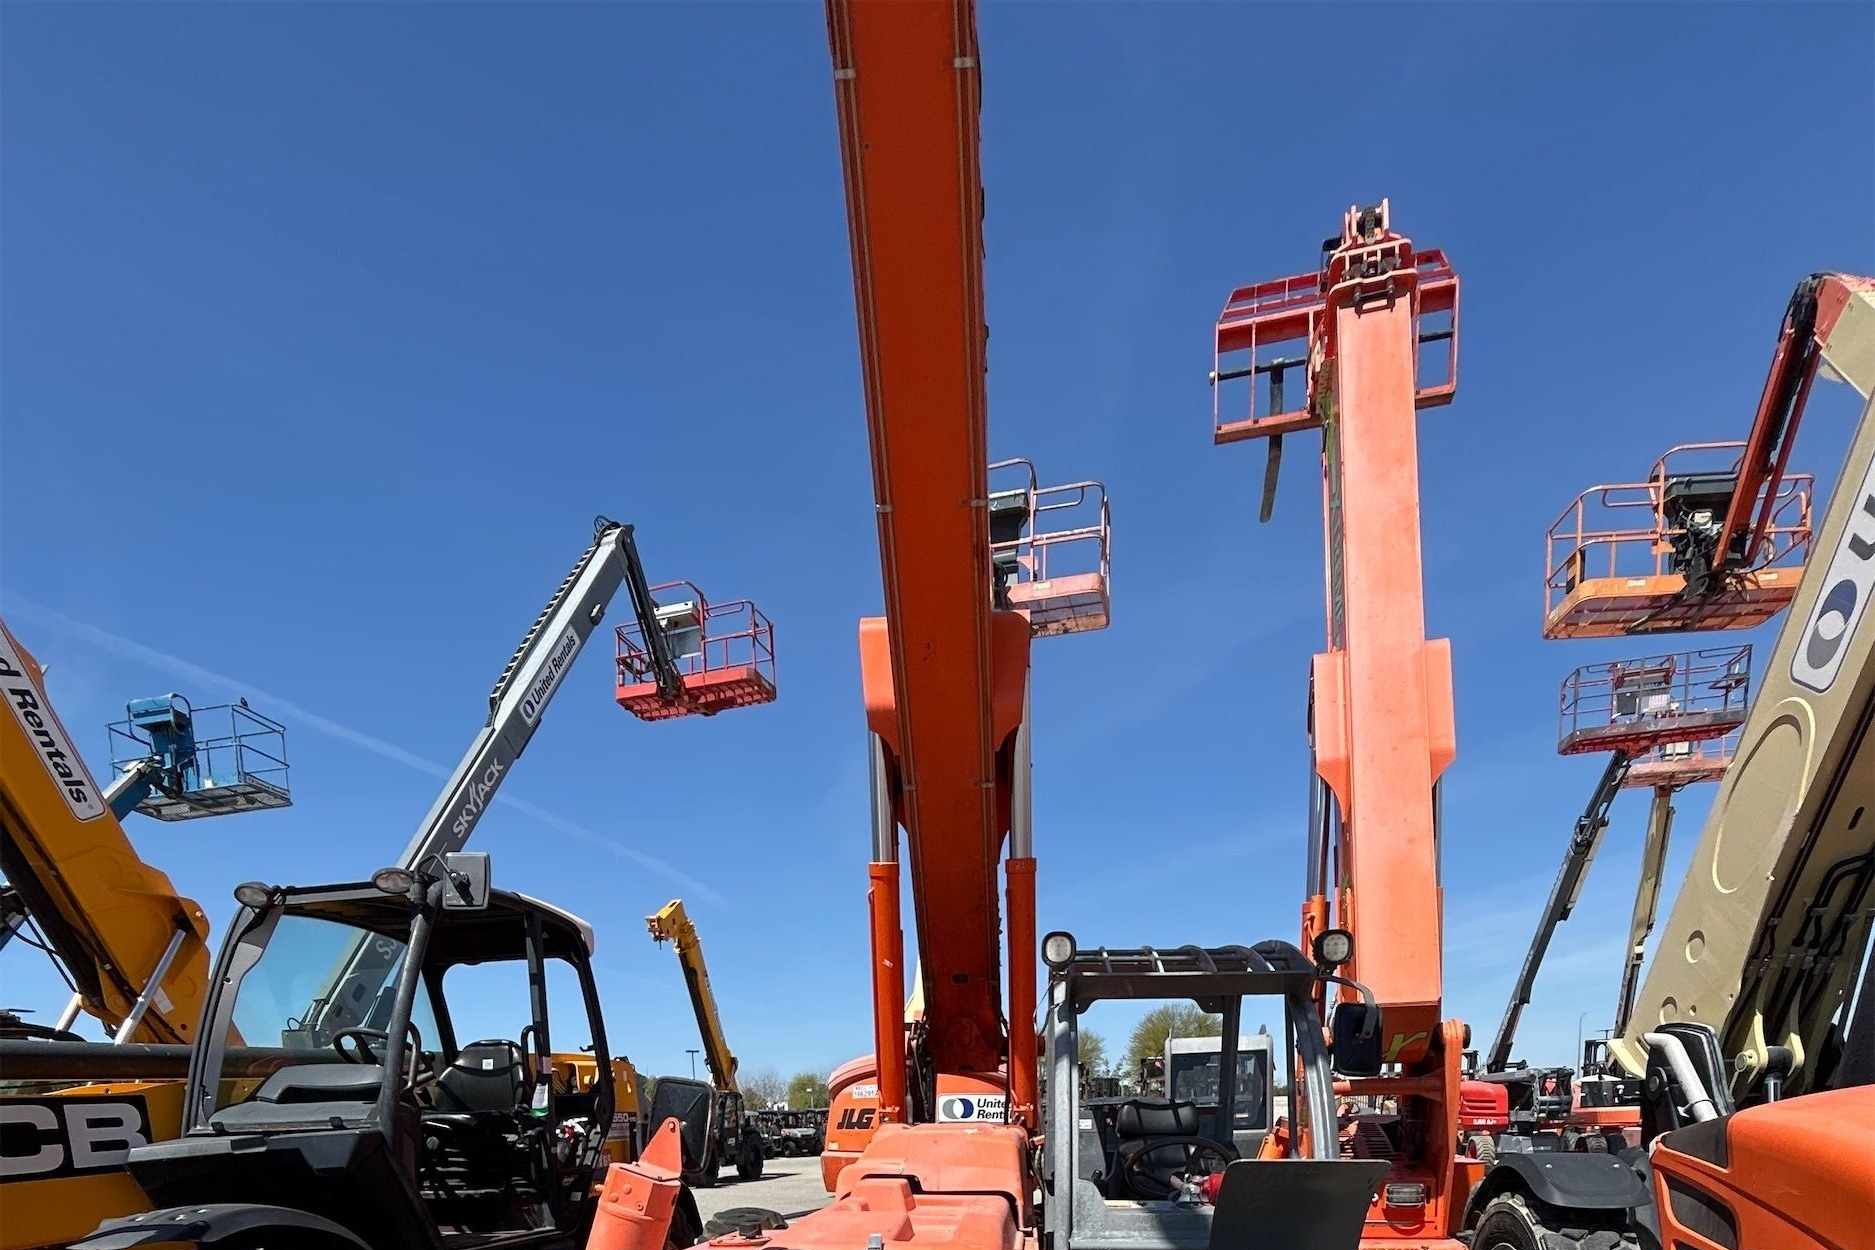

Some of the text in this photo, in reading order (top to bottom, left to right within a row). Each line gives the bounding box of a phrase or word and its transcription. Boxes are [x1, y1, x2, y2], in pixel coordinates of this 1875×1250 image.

[530, 635, 577, 705] United Rentals
[8, 688, 88, 803] Rentals
[452, 757, 504, 839] SKYJACK
[0, 1103, 148, 1176] CB
[837, 1108, 876, 1130] JLG
